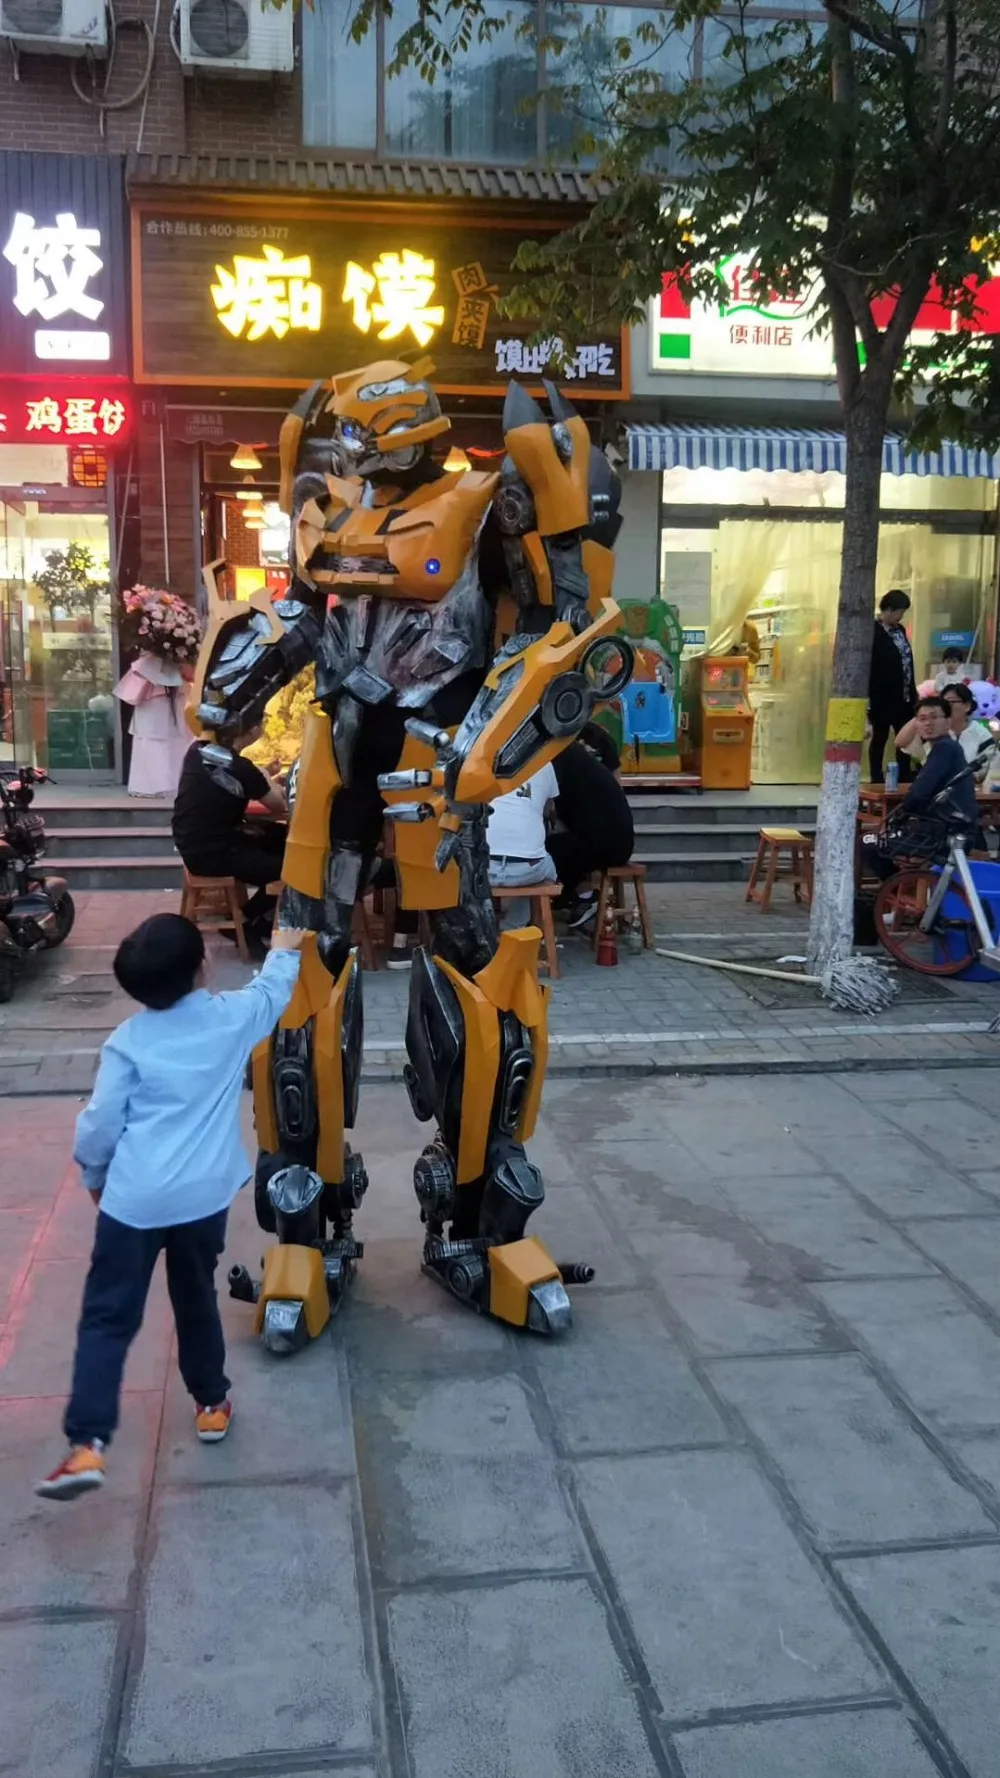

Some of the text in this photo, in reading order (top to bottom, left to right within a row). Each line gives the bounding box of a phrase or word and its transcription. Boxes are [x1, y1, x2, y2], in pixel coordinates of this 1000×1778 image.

[3, 212, 105, 321] 饺
[730, 324, 792, 346] 便利店
